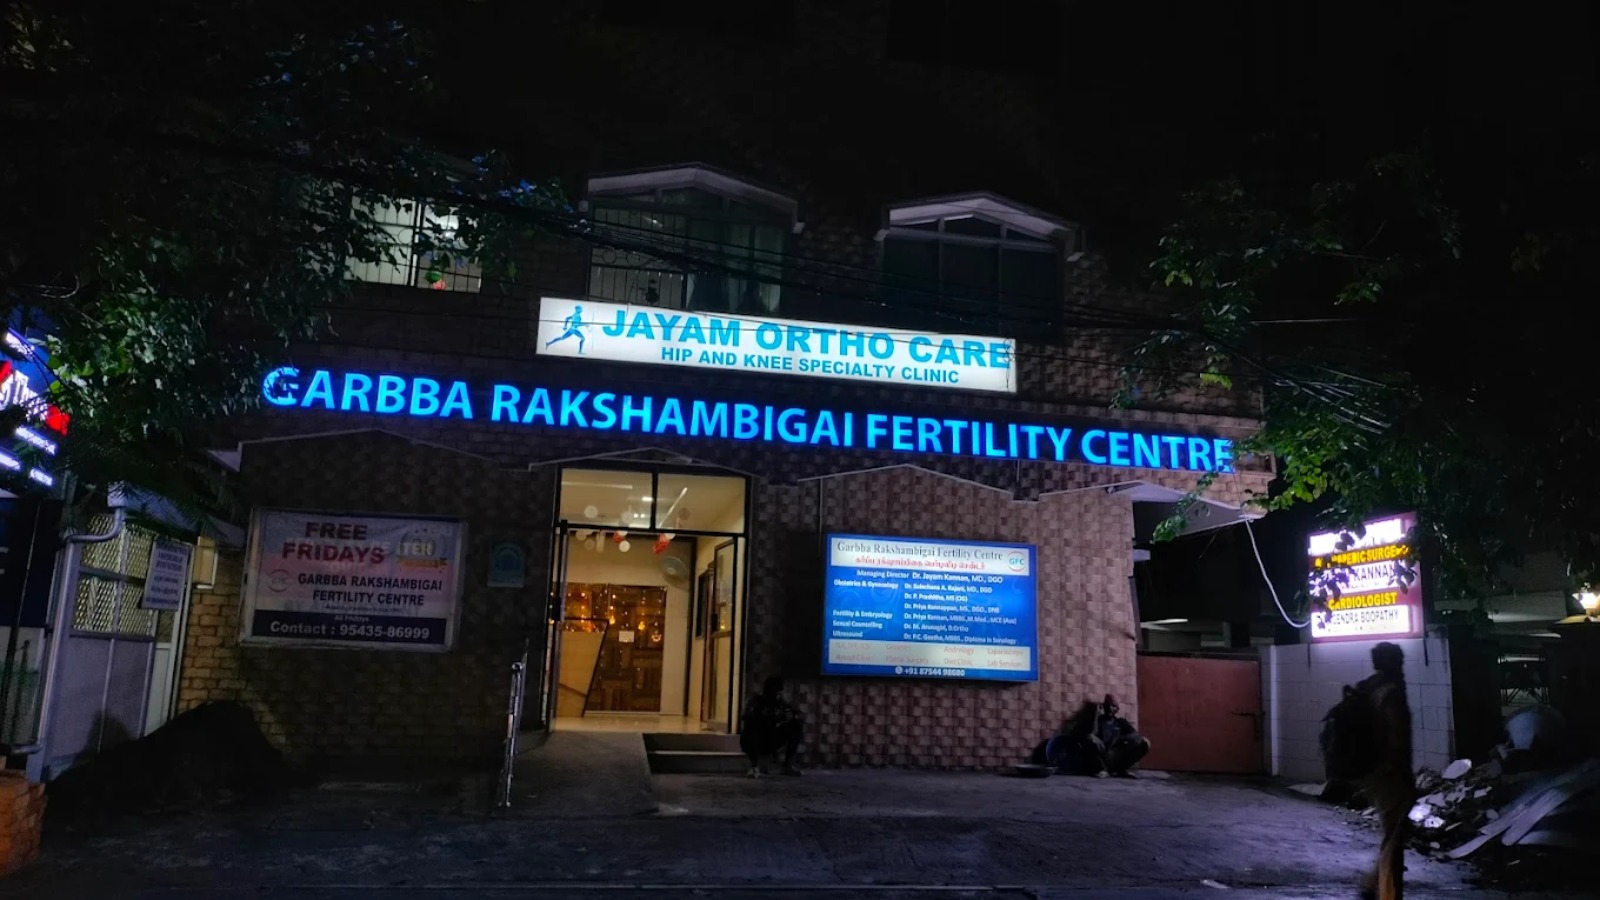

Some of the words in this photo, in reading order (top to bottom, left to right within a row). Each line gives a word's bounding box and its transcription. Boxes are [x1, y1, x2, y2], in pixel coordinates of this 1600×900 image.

[602, 309, 741, 347] JAYAM
[755, 321, 895, 359] ORTHO
[908, 336, 1011, 369] CARE
[661, 346, 693, 362] HIP
[698, 348, 738, 367] AND
[743, 355, 793, 372] KNEE
[798, 357, 894, 380] SPECIALTY
[901, 366, 960, 385] CLINIC
[262, 366, 474, 420] GARBBA
[490, 383, 853, 448] RAKSHAMBIGAI
[866, 413, 1073, 462] FERTILITY
[1080, 428, 1235, 474] CENTRE
[305, 521, 368, 541] FREE
[282, 541, 385, 565] FRIDAYS
[837, 541, 871, 554] Garbba
[874, 544, 935, 558] Rakshambigai
[937, 547, 972, 561] Fertility
[974, 549, 1004, 561] Centre
[1008, 557, 1025, 566] GFC
[298, 573, 347, 586] GARBBA
[351, 576, 443, 591] RAKSHAMBIGAI
[857, 569, 886, 580] Managing
[887, 571, 909, 579] Director
[912, 572, 922, 580] Dr.
[923, 572, 943, 583] Jayam
[944, 574, 970, 583] Kannan,
[988, 576, 1004, 584] DGO
[313, 590, 374, 604] FERTILITY
[377, 593, 425, 606] CENTRE
[1328, 591, 1397, 610] CARDIOLOGIST
[833, 609, 854, 618] Fertility
[270, 620, 326, 635] Contact
[339, 624, 430, 639] 95435-86999
[904, 667, 918, 675] +91
